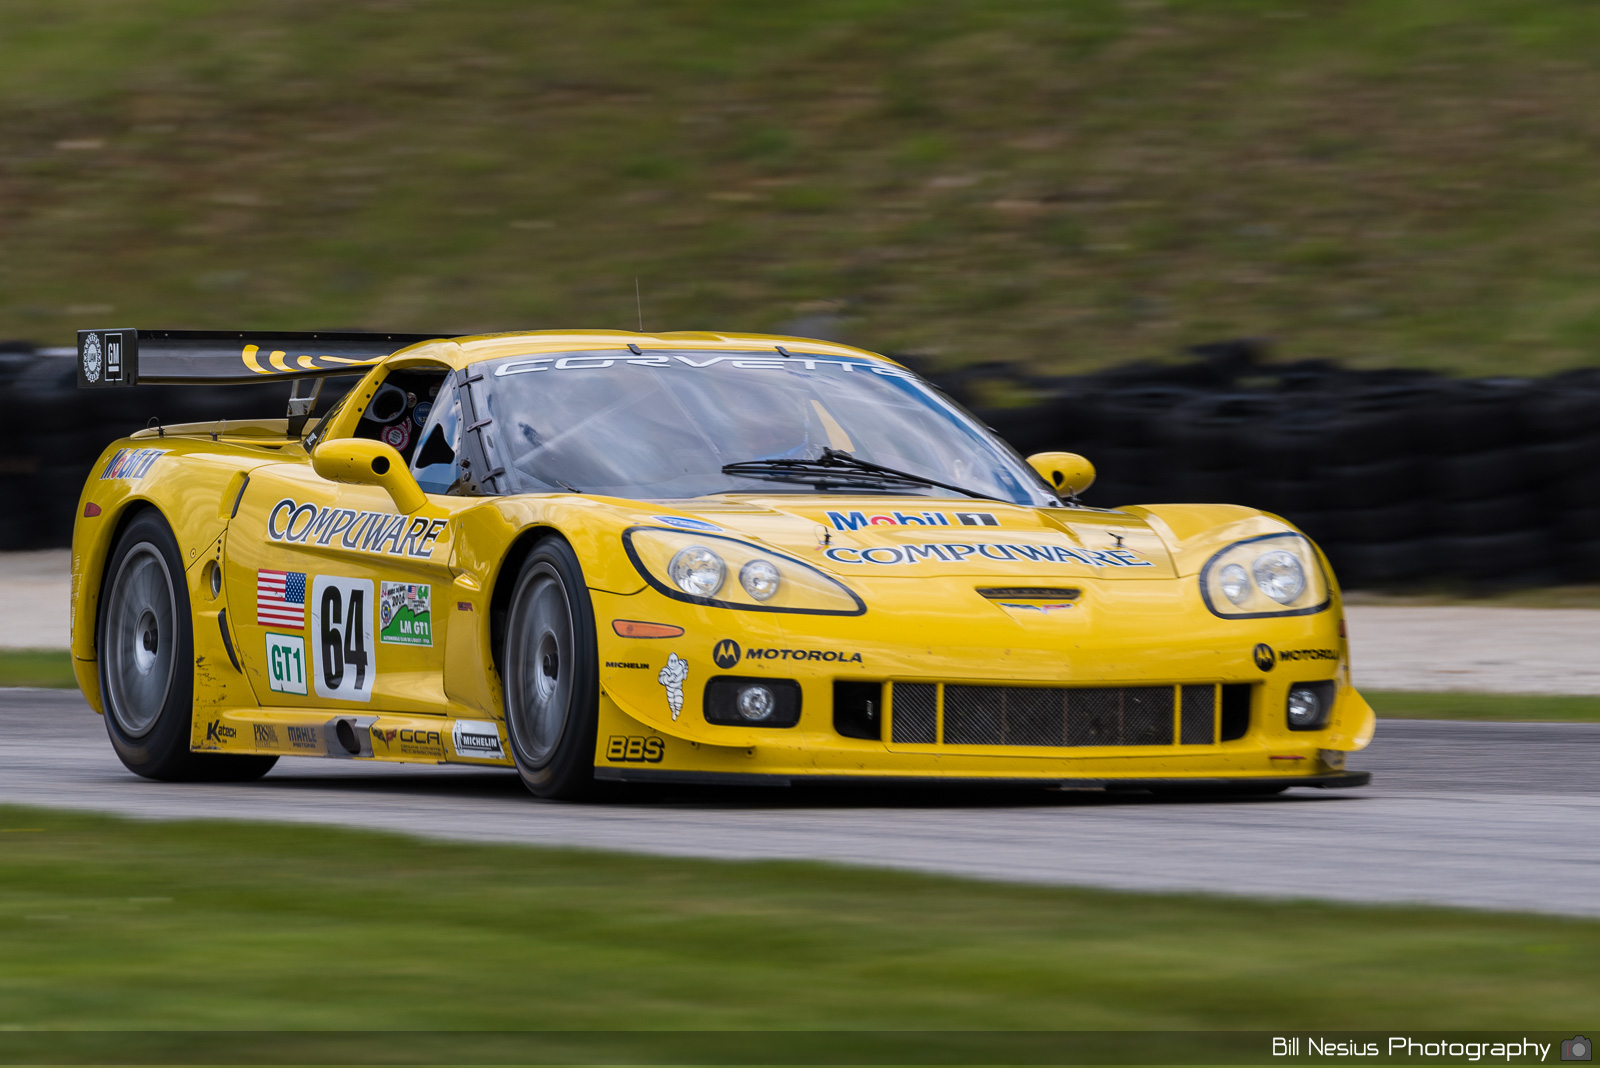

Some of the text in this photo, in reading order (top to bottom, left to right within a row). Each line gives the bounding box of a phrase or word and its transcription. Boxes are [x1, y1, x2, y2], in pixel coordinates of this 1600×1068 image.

[108, 342, 119, 364] GM
[494, 354, 919, 381] CORVETTE
[99, 448, 152, 480] Mobil
[267, 498, 450, 559] COMPUWARE
[823, 510, 951, 532] Mobil
[823, 543, 1156, 567] COMPUWARE
[418, 585, 429, 600] 64
[320, 585, 368, 690] 64
[400, 620, 429, 636] LM GT1
[271, 643, 302, 684] GT1
[605, 660, 650, 670] MICHELIN
[745, 648, 863, 663] MOTOROLA
[253, 723, 270, 741] PRS
[287, 726, 317, 743] MAHLE
[400, 729, 440, 745] GCA
[463, 736, 497, 748] MICHELIN
[606, 735, 665, 763] BBS
